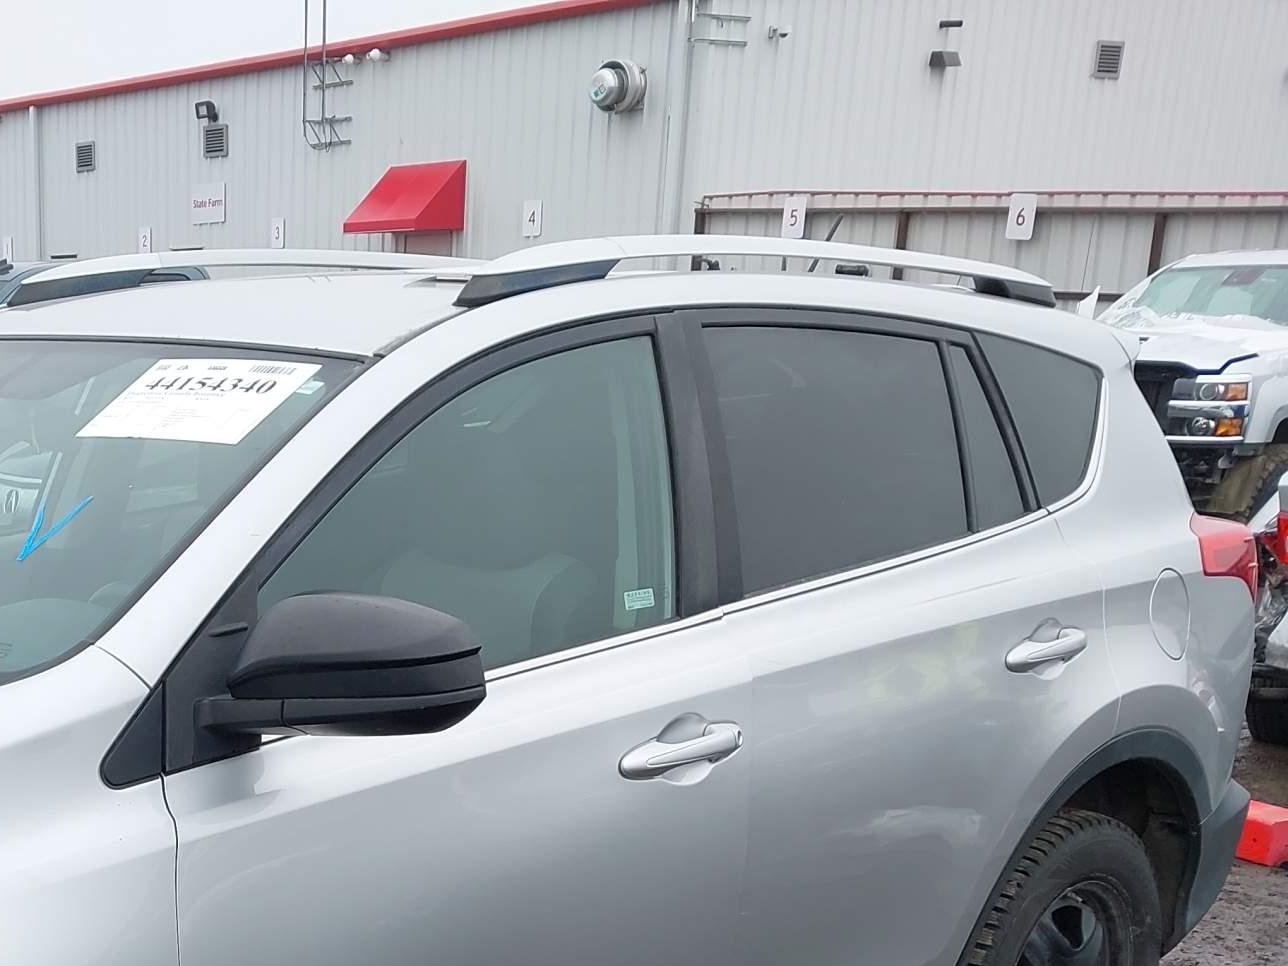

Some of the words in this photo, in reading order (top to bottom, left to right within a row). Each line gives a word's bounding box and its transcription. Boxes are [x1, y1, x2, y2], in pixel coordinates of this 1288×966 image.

[192, 199, 207, 209] State
[208, 198, 223, 208] Farm
[528, 209, 536, 226] 4
[789, 208, 799, 226] 5
[1015, 207, 1026, 226] 6
[142, 234, 148, 248] 2
[274, 225, 280, 240] 3
[145, 376, 278, 394] 44154340
